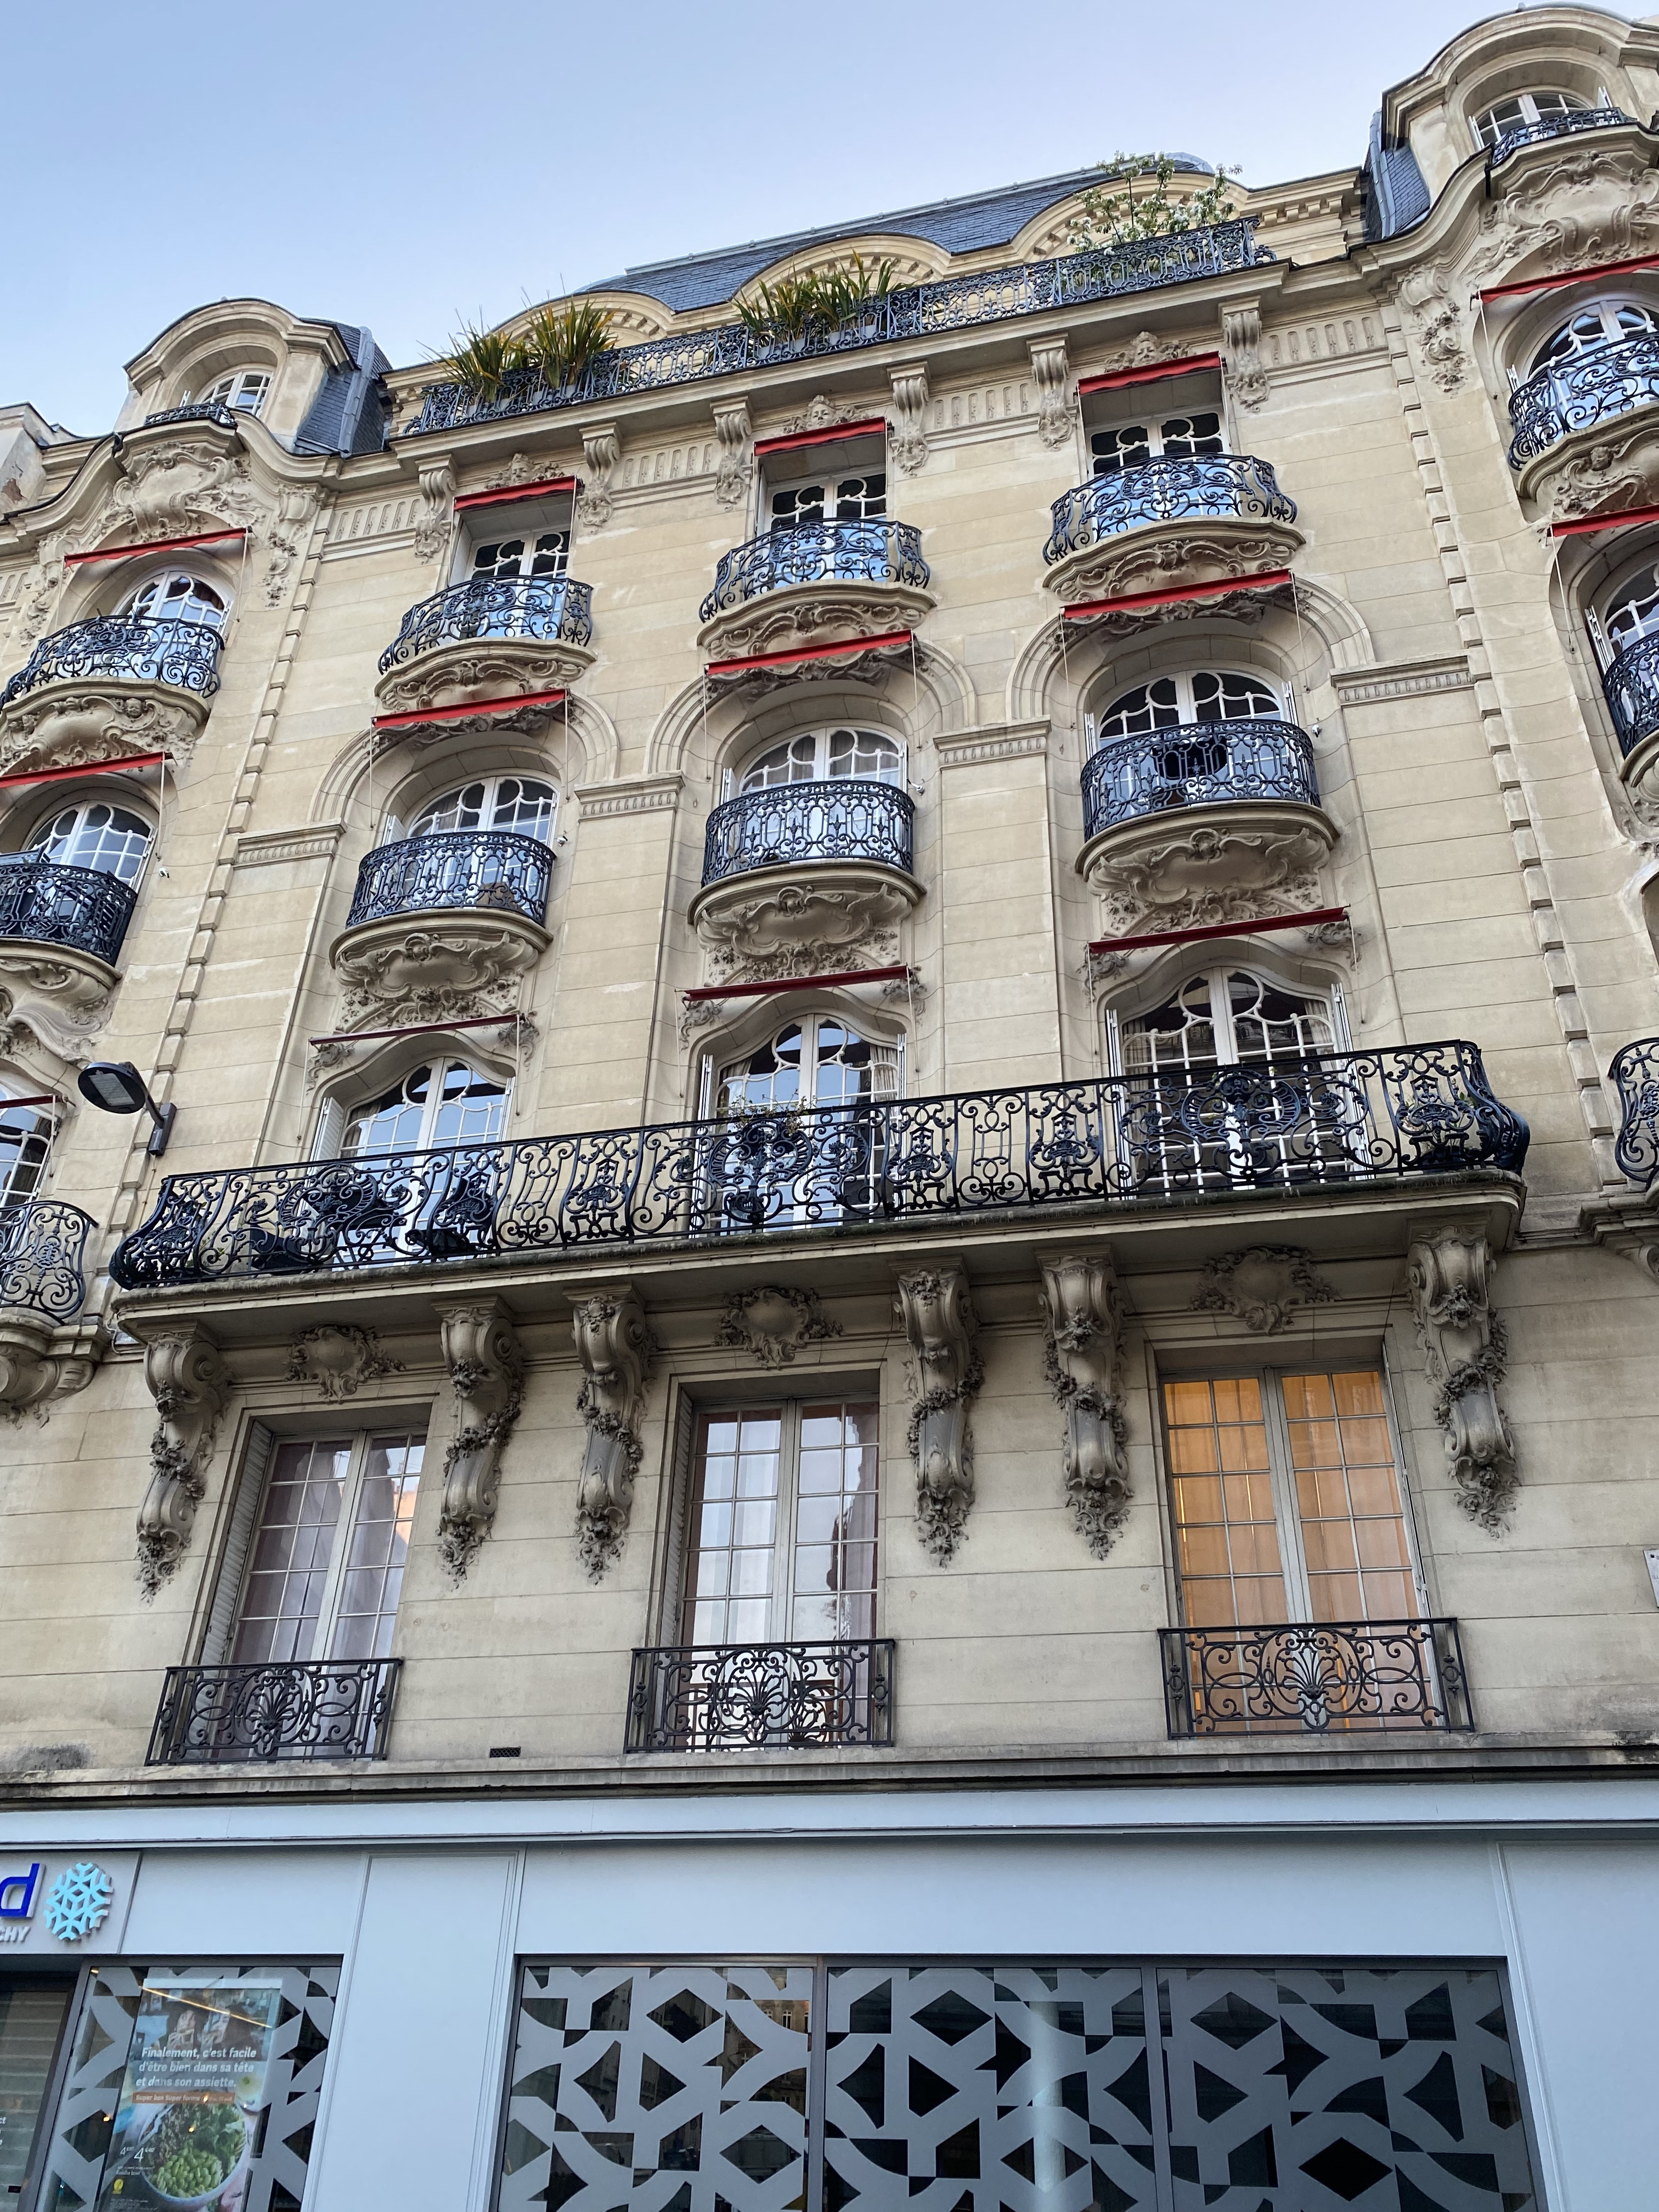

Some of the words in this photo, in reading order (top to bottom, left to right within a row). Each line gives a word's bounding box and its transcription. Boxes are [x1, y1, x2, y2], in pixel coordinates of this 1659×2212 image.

[0, 1863, 41, 1917] d
[142, 2047, 200, 2059] Finalement,
[202, 2047, 226, 2058] c'est
[229, 2047, 257, 2058] facile
[139, 2061, 167, 2072] d'être
[170, 2061, 190, 2072] bien
[193, 2061, 217, 2072] dans
[234, 2061, 254, 2073] tête
[136, 2077, 146, 2086] et
[148, 2076, 172, 2086] dans
[175, 2078, 192, 2086] son
[194, 2076, 236, 2087] assiette.
